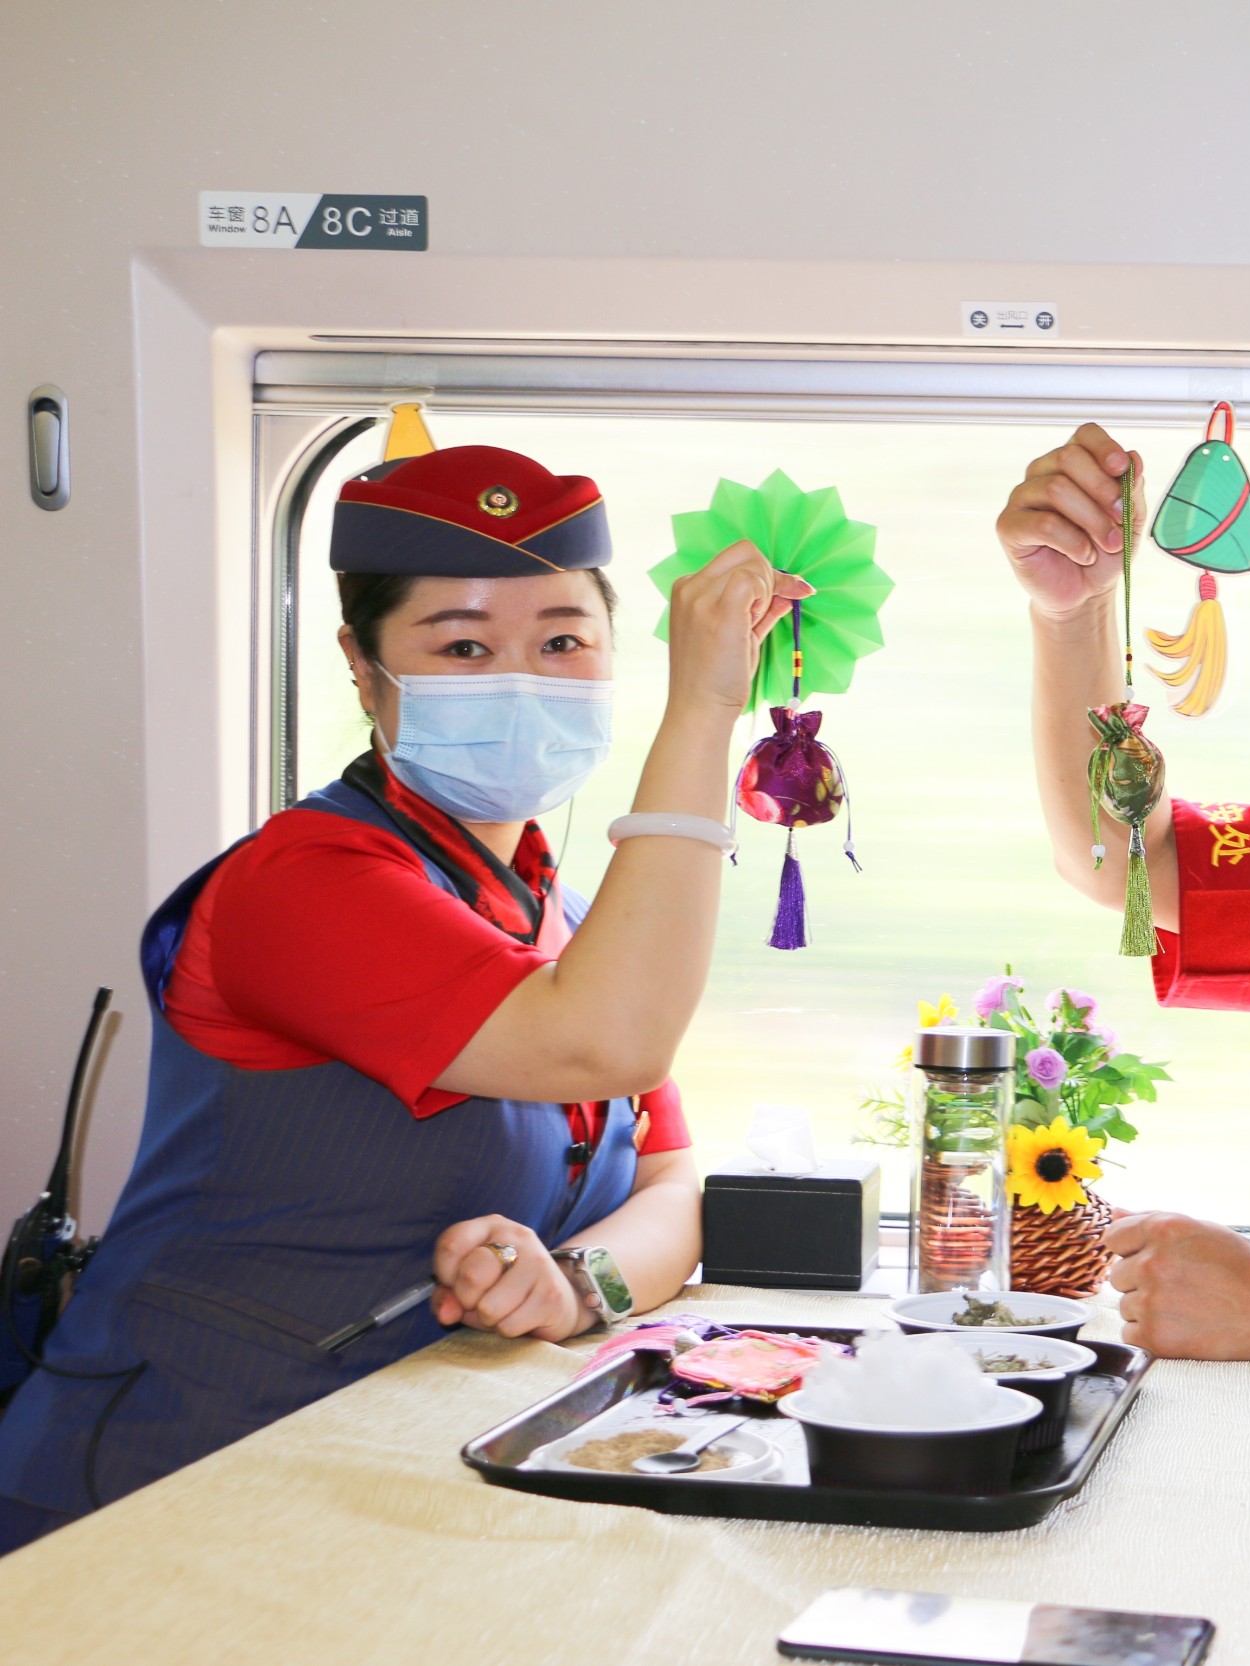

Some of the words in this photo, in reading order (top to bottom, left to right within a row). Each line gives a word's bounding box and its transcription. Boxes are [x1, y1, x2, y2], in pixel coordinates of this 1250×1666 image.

[208, 205, 246, 223] 车窗
[252, 205, 298, 235] 8A
[322, 206, 373, 236] 8C
[378, 207, 420, 226] 过道
[208, 224, 247, 234] Window
[388, 227, 413, 237] Aisle
[972, 312, 987, 326] 关
[1037, 314, 1052, 327] 开
